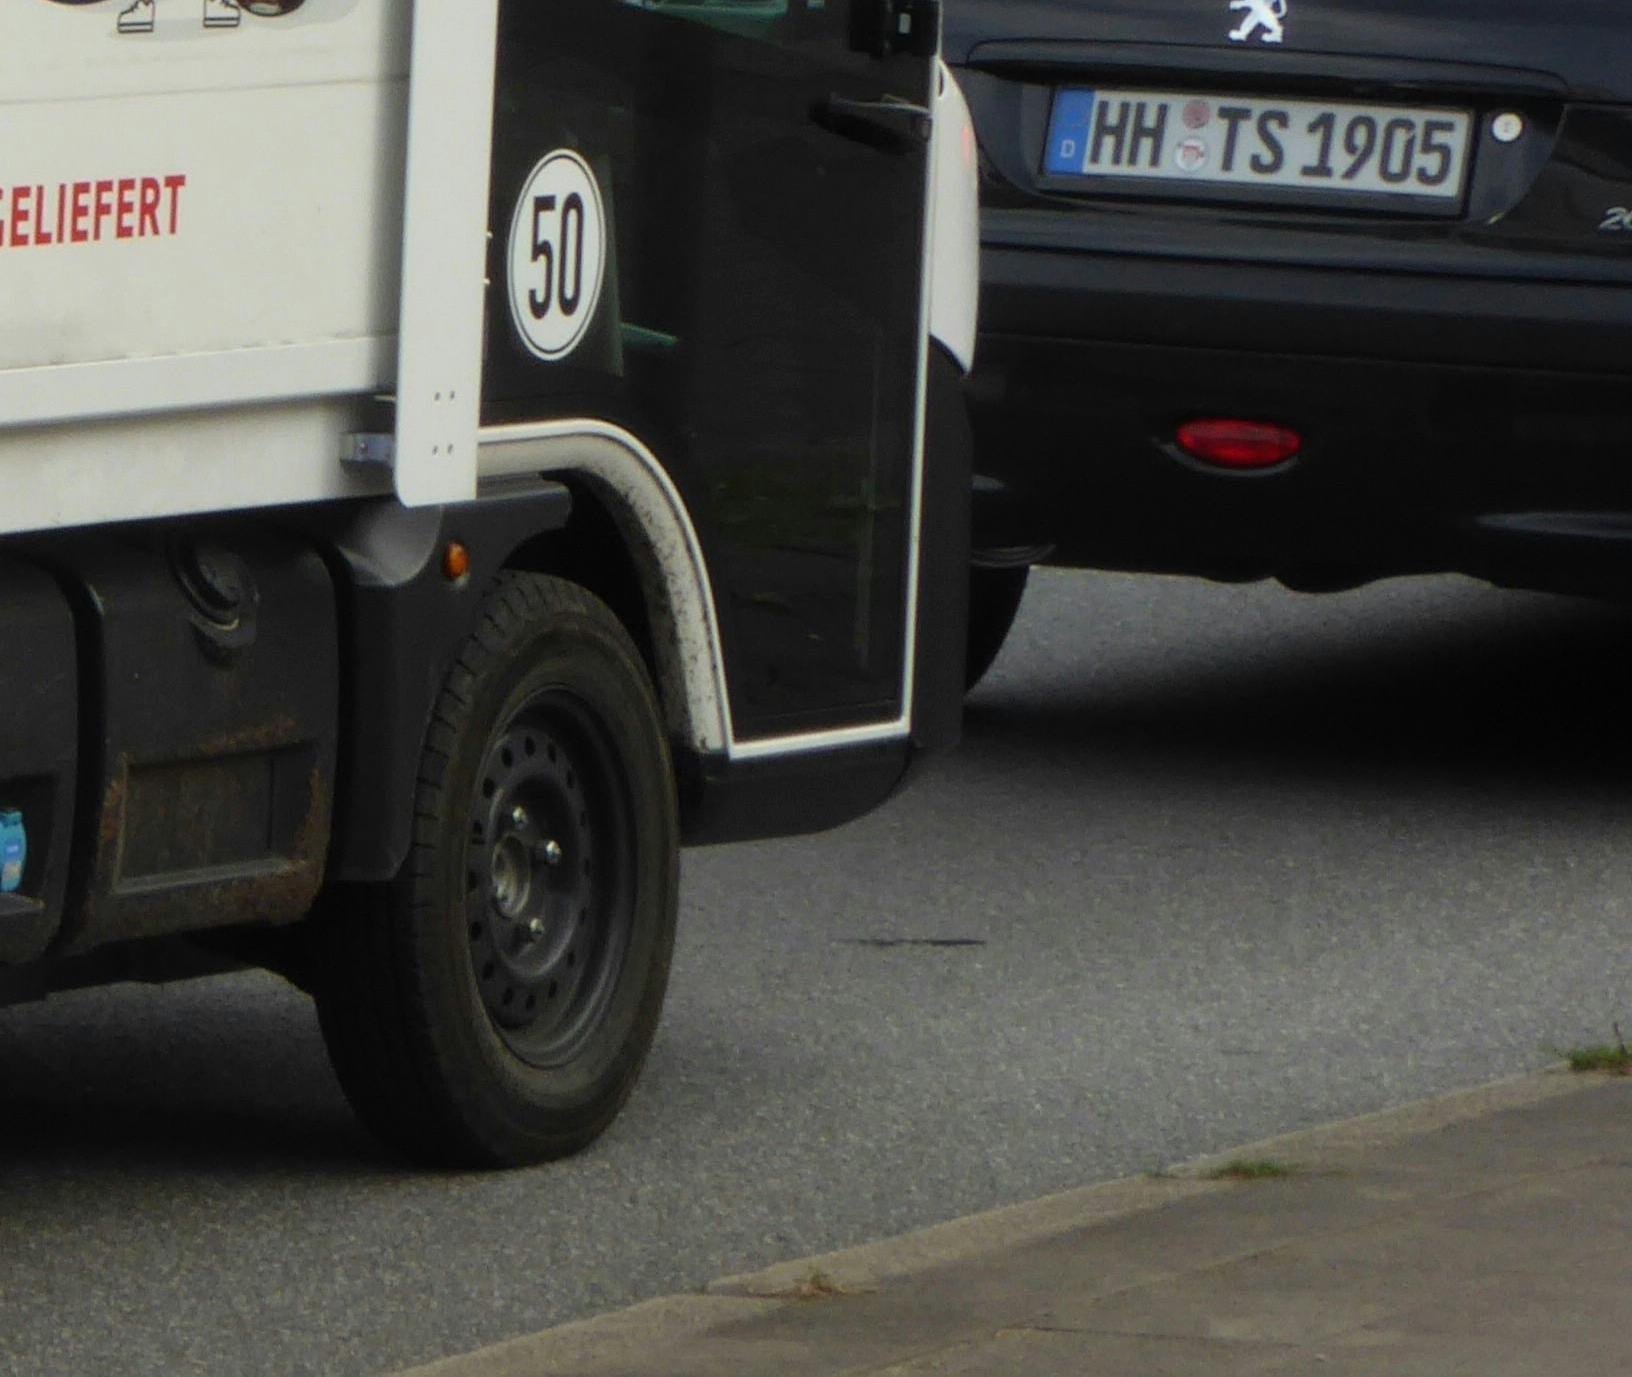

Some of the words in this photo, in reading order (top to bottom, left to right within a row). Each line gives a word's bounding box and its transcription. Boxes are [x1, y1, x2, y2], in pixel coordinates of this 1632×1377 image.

[1089, 99, 1169, 168] HH
[1218, 105, 1290, 176] TS
[1299, 111, 1456, 186] 1905
[528, 191, 584, 320] 50
